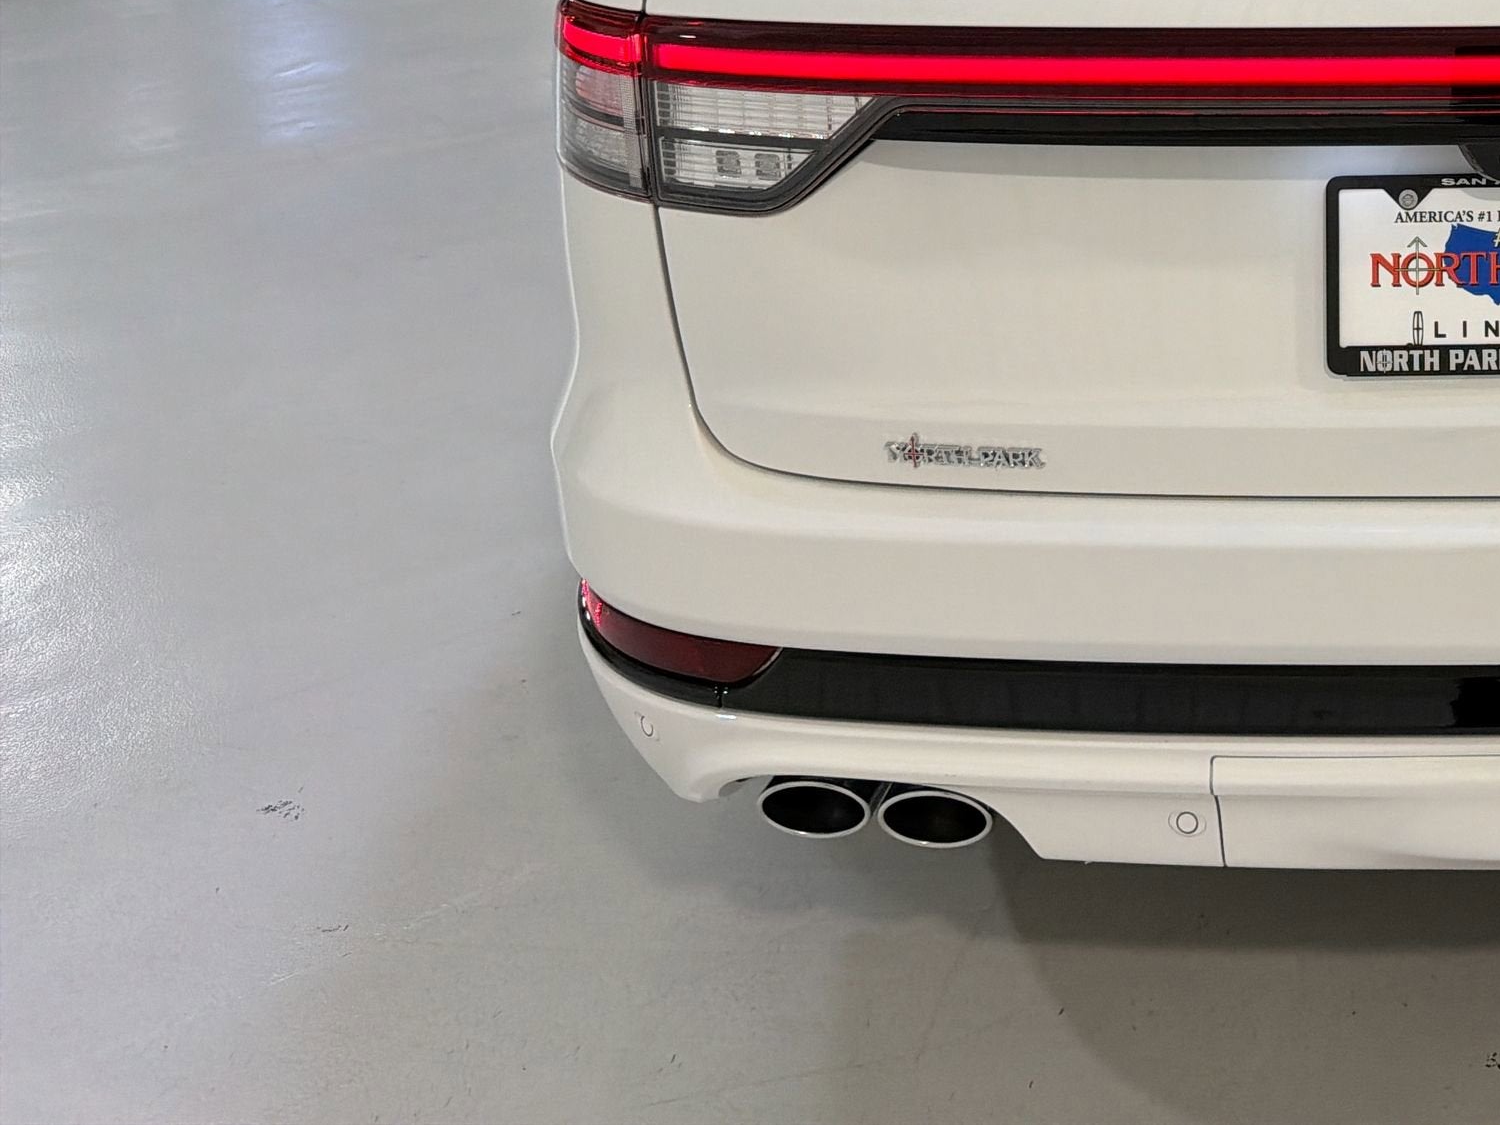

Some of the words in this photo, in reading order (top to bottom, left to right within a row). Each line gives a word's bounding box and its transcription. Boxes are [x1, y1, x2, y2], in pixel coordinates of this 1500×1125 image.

[1440, 177, 1487, 186] SAN
[1394, 210, 1474, 224] AMERICA'S
[1477, 210, 1493, 223] #1
[1360, 349, 1441, 372] NORTH
[977, 446, 1046, 470] PARK
